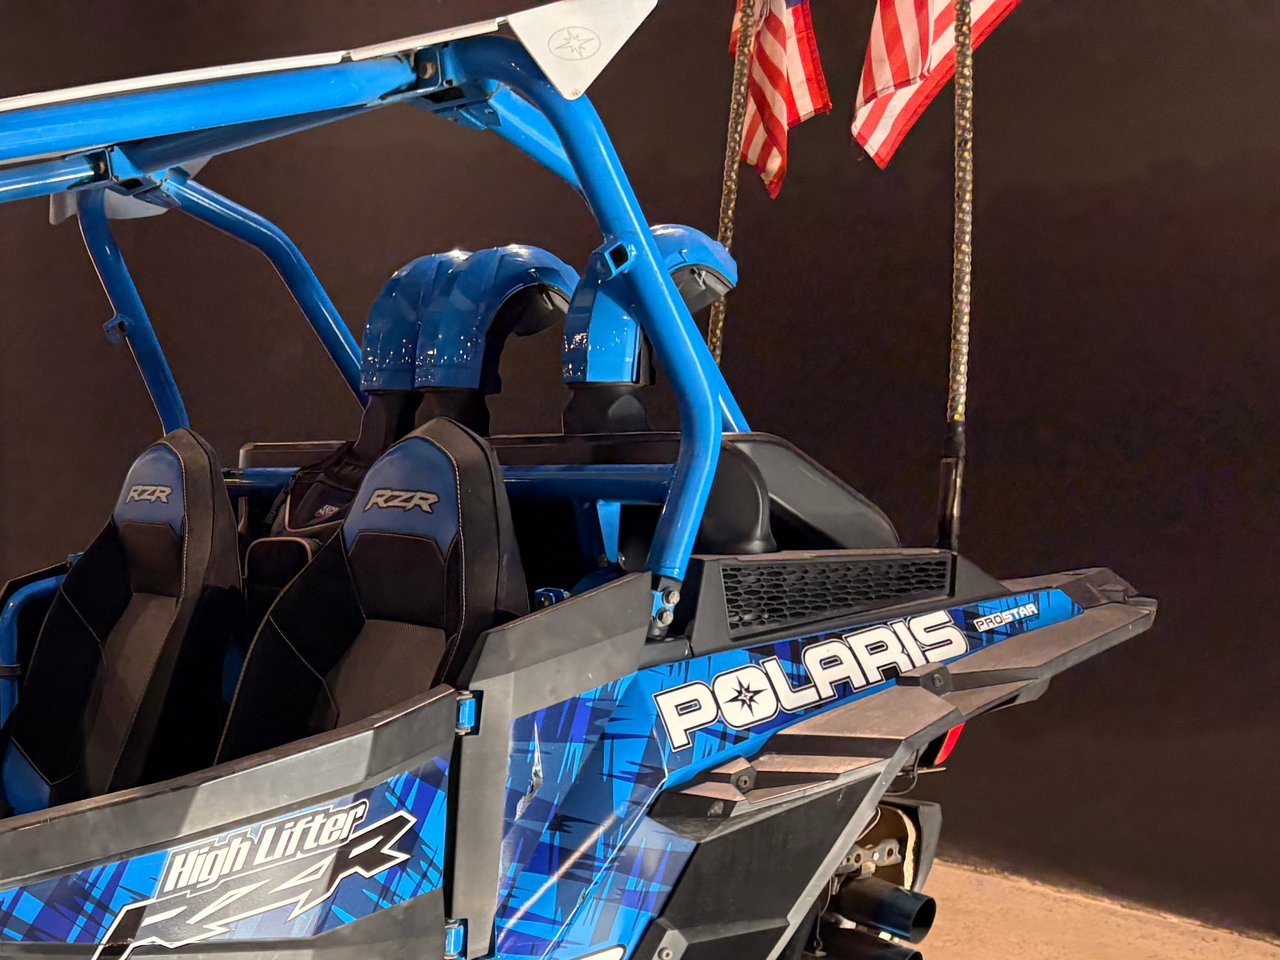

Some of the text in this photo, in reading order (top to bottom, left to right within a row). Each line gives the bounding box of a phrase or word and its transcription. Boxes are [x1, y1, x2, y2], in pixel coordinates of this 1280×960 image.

[124, 484, 174, 504] RZR
[363, 487, 440, 515] RZR
[973, 603, 1039, 632] PROSTAR
[653, 610, 971, 752] POLARIS
[162, 804, 367, 894] High Lifter
